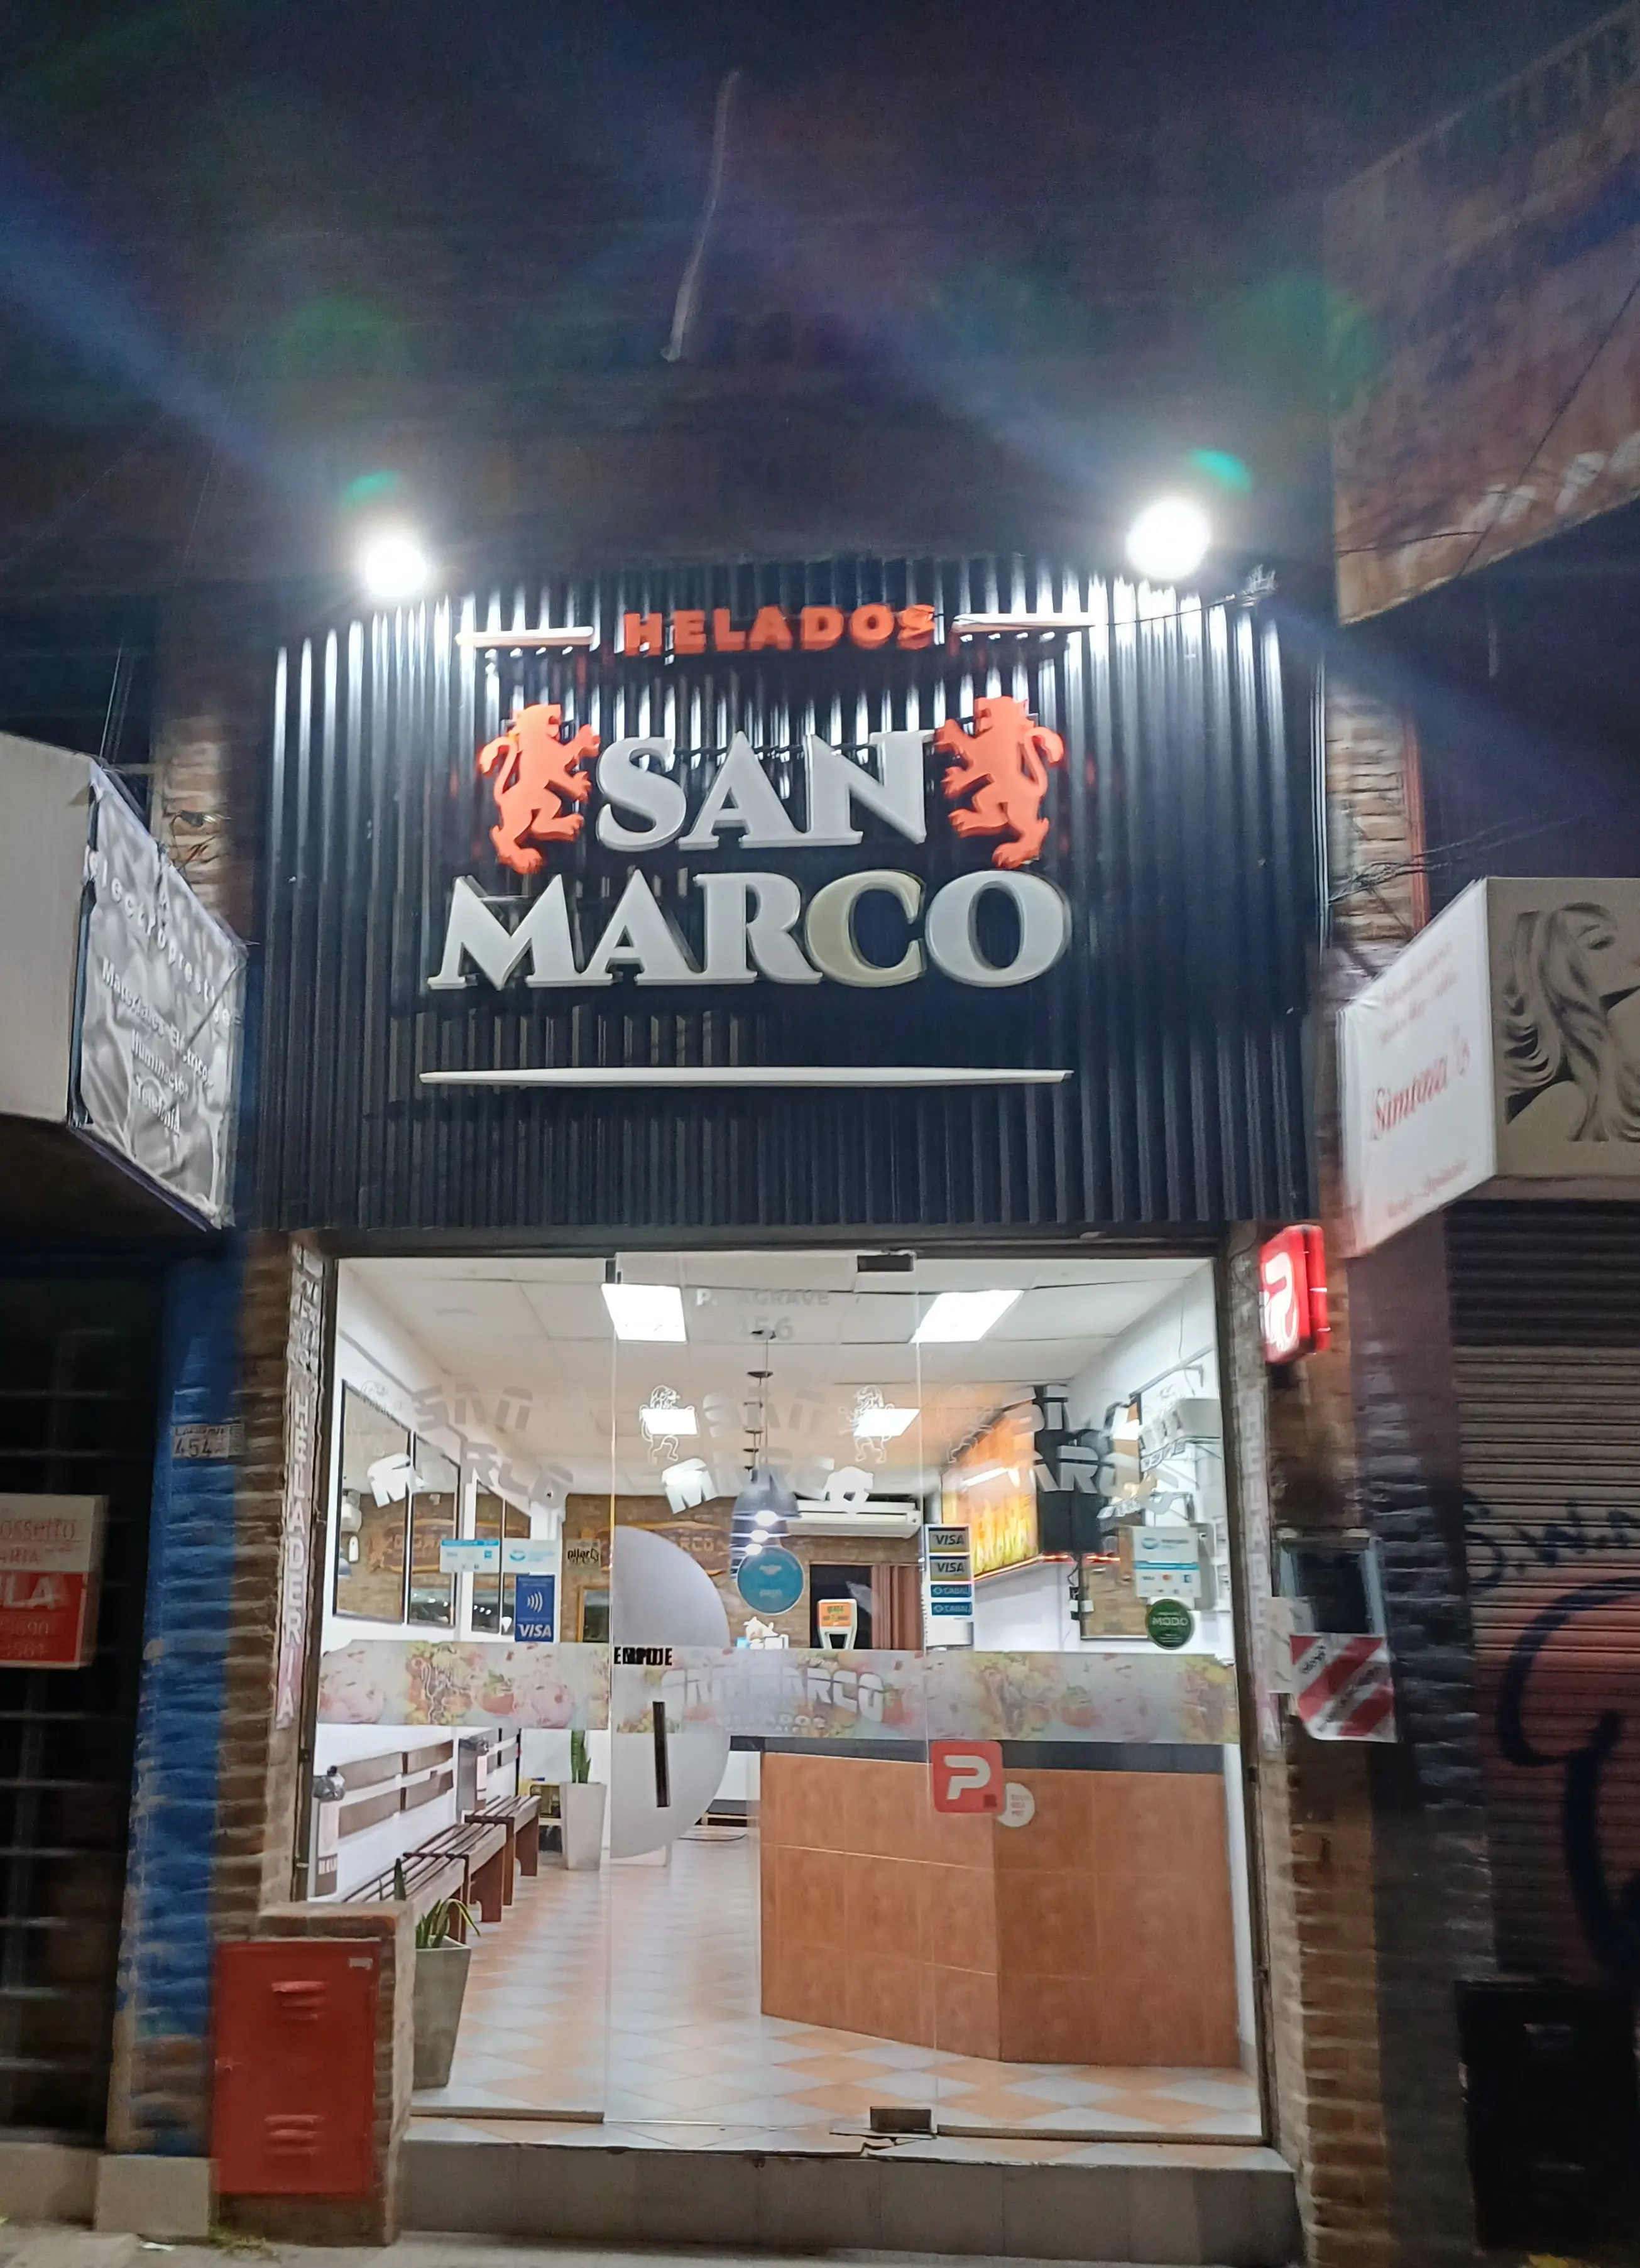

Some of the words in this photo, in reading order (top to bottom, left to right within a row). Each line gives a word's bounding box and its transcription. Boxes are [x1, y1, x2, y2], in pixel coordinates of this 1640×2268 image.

[623, 604, 935, 657] HELADOS
[596, 731, 934, 852] SAN
[427, 869, 1072, 991] MARCO
[276, 1391, 309, 1726] HELADERIA
[934, 1534, 965, 1546] VISA
[937, 1562, 965, 1573] VISA
[0, 1571, 56, 1610] LA
[517, 1623, 552, 1638] VISA
[1152, 1616, 1189, 1627] MODO
[943, 1755, 992, 1801] P
